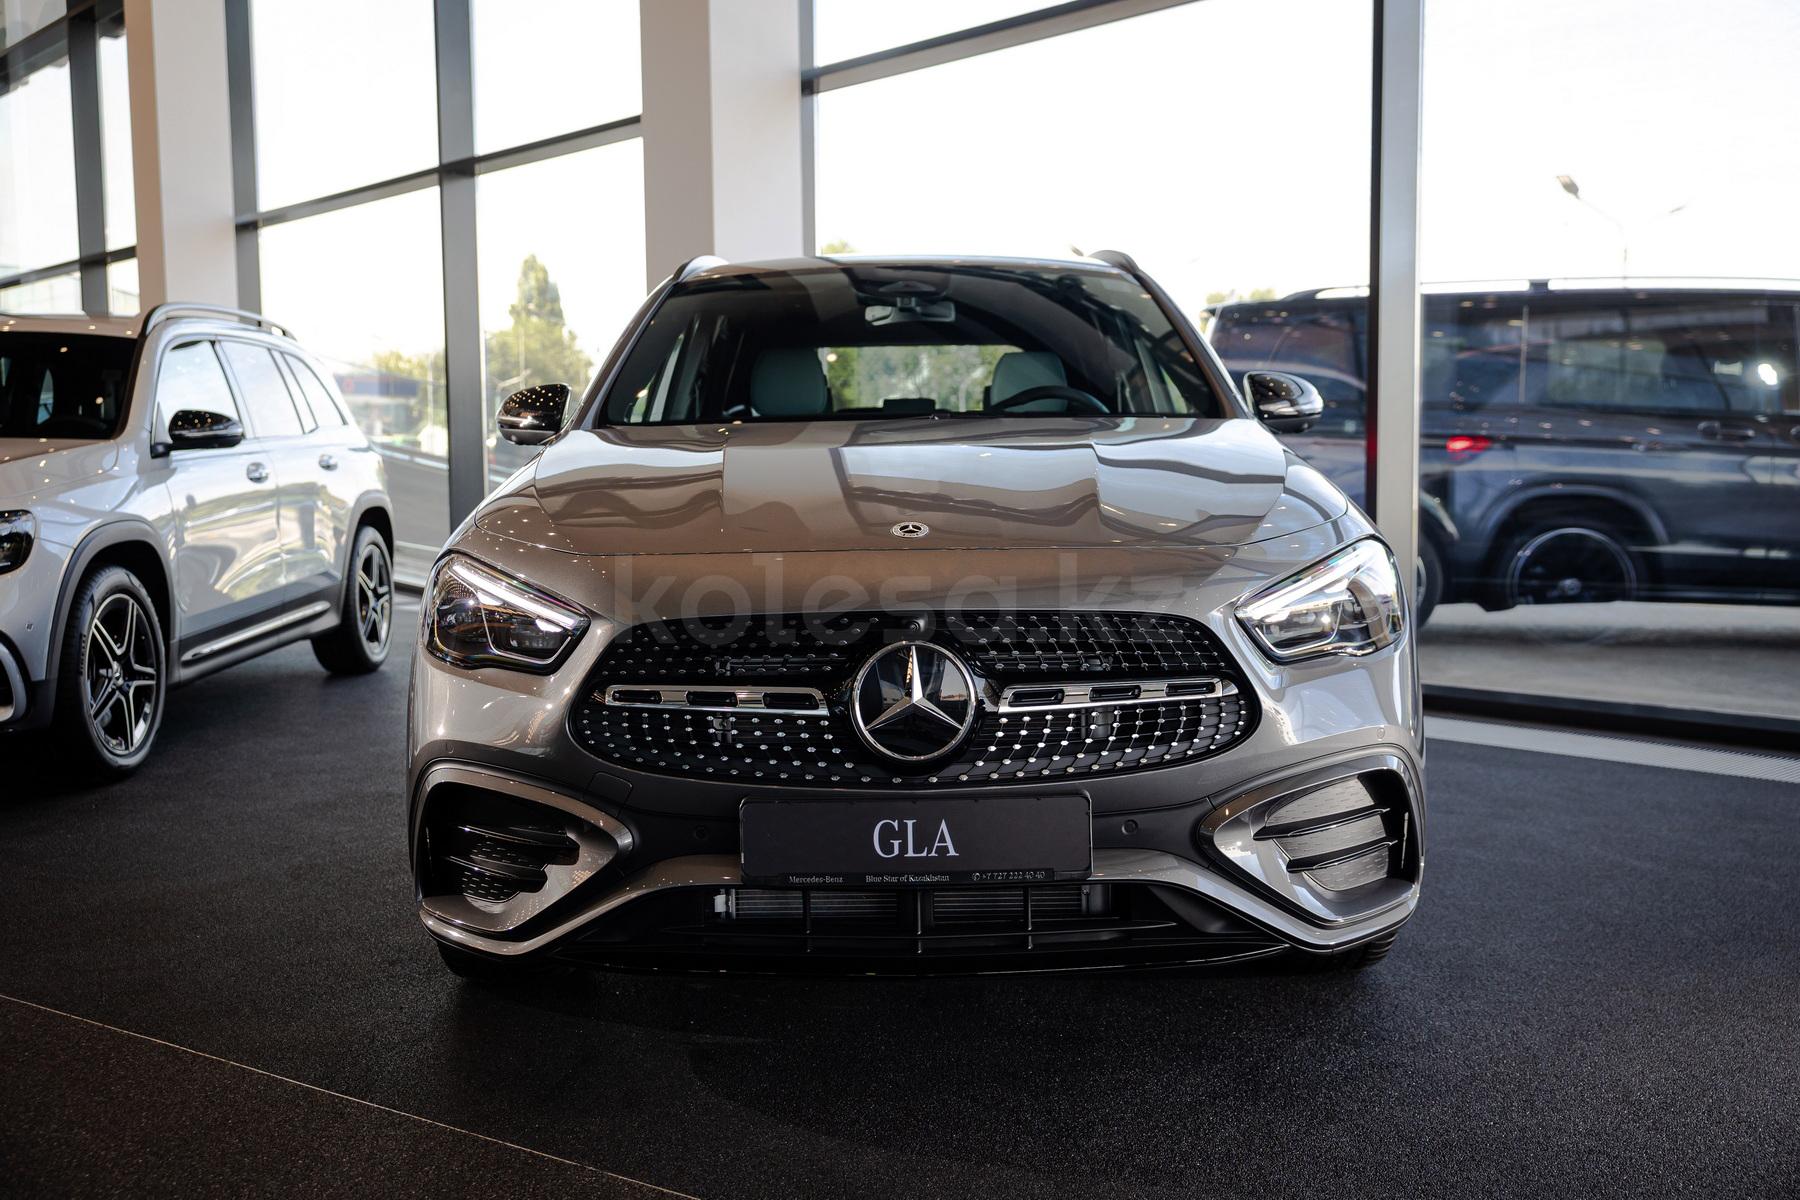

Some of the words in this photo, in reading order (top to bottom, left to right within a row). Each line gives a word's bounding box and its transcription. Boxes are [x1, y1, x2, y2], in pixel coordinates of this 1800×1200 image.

[873, 819, 960, 858] GLA
[788, 875, 843, 884] Mercedes-Benz
[865, 875, 882, 883] Blue
[883, 875, 898, 883] Star
[908, 874, 950, 882] Kazakhstan
